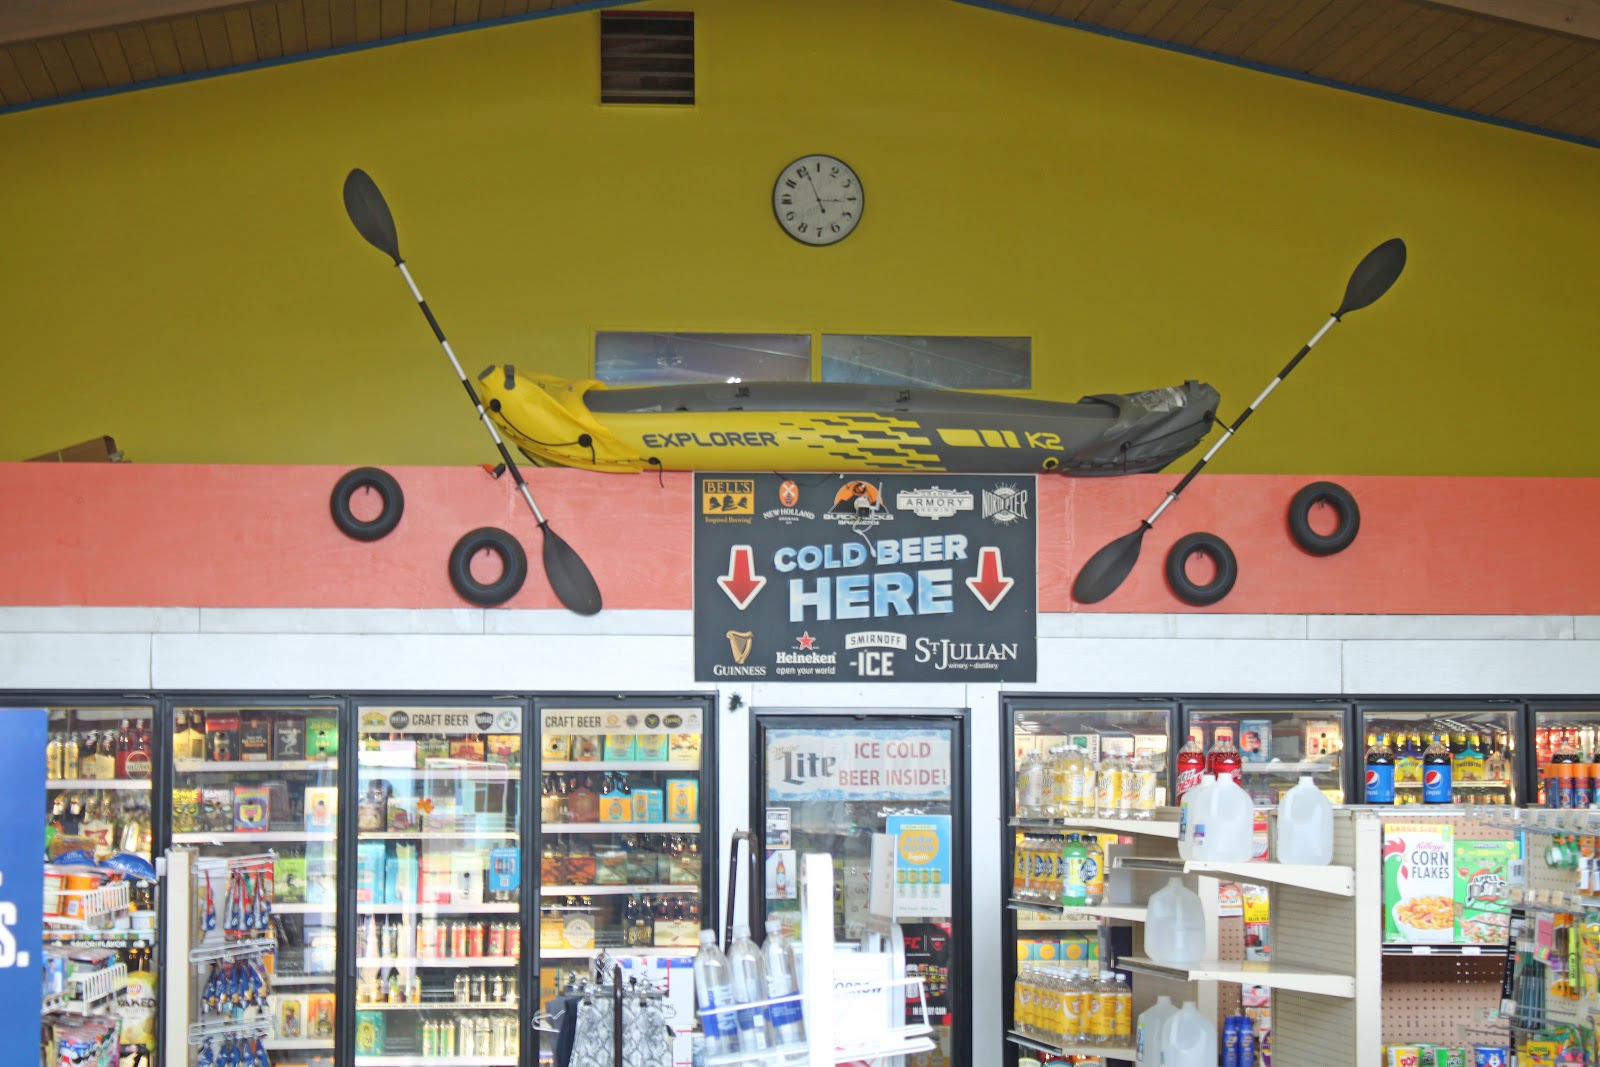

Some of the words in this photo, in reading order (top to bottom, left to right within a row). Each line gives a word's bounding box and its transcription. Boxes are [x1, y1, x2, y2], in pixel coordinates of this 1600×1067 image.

[816, 226, 824, 237] 7
[642, 431, 778, 449] EXPLORER
[1024, 431, 1065, 451] K2
[706, 481, 751, 494] BELL'S
[905, 498, 965, 507] ARMORY
[762, 509, 780, 520] NEW
[780, 507, 816, 520] HOLLAND
[823, 513, 895, 521] BLACKOCKS
[773, 542, 868, 573] COLD
[875, 533, 969, 567] BEER
[788, 568, 955, 623] HERE
[850, 634, 902, 646] SMIRNOFF
[775, 651, 837, 664] Heineken
[712, 664, 767, 676] GUINNESS
[775, 667, 796, 676] open
[796, 667, 814, 676] your
[815, 666, 836, 675] world
[411, 713, 442, 727] CRAFT
[444, 713, 469, 727] BEER
[545, 715, 573, 728] CRAFT
[576, 715, 601, 728] BEER
[854, 742, 880, 759] ICE
[886, 742, 931, 759] COLD
[782, 751, 837, 785] Lite
[838, 769, 880, 786] BEER
[885, 769, 947, 786] INSIDE!
[1411, 851, 1449, 865] CORN
[1411, 866, 1450, 879] FLAKES
[903, 936, 922, 950] FC
